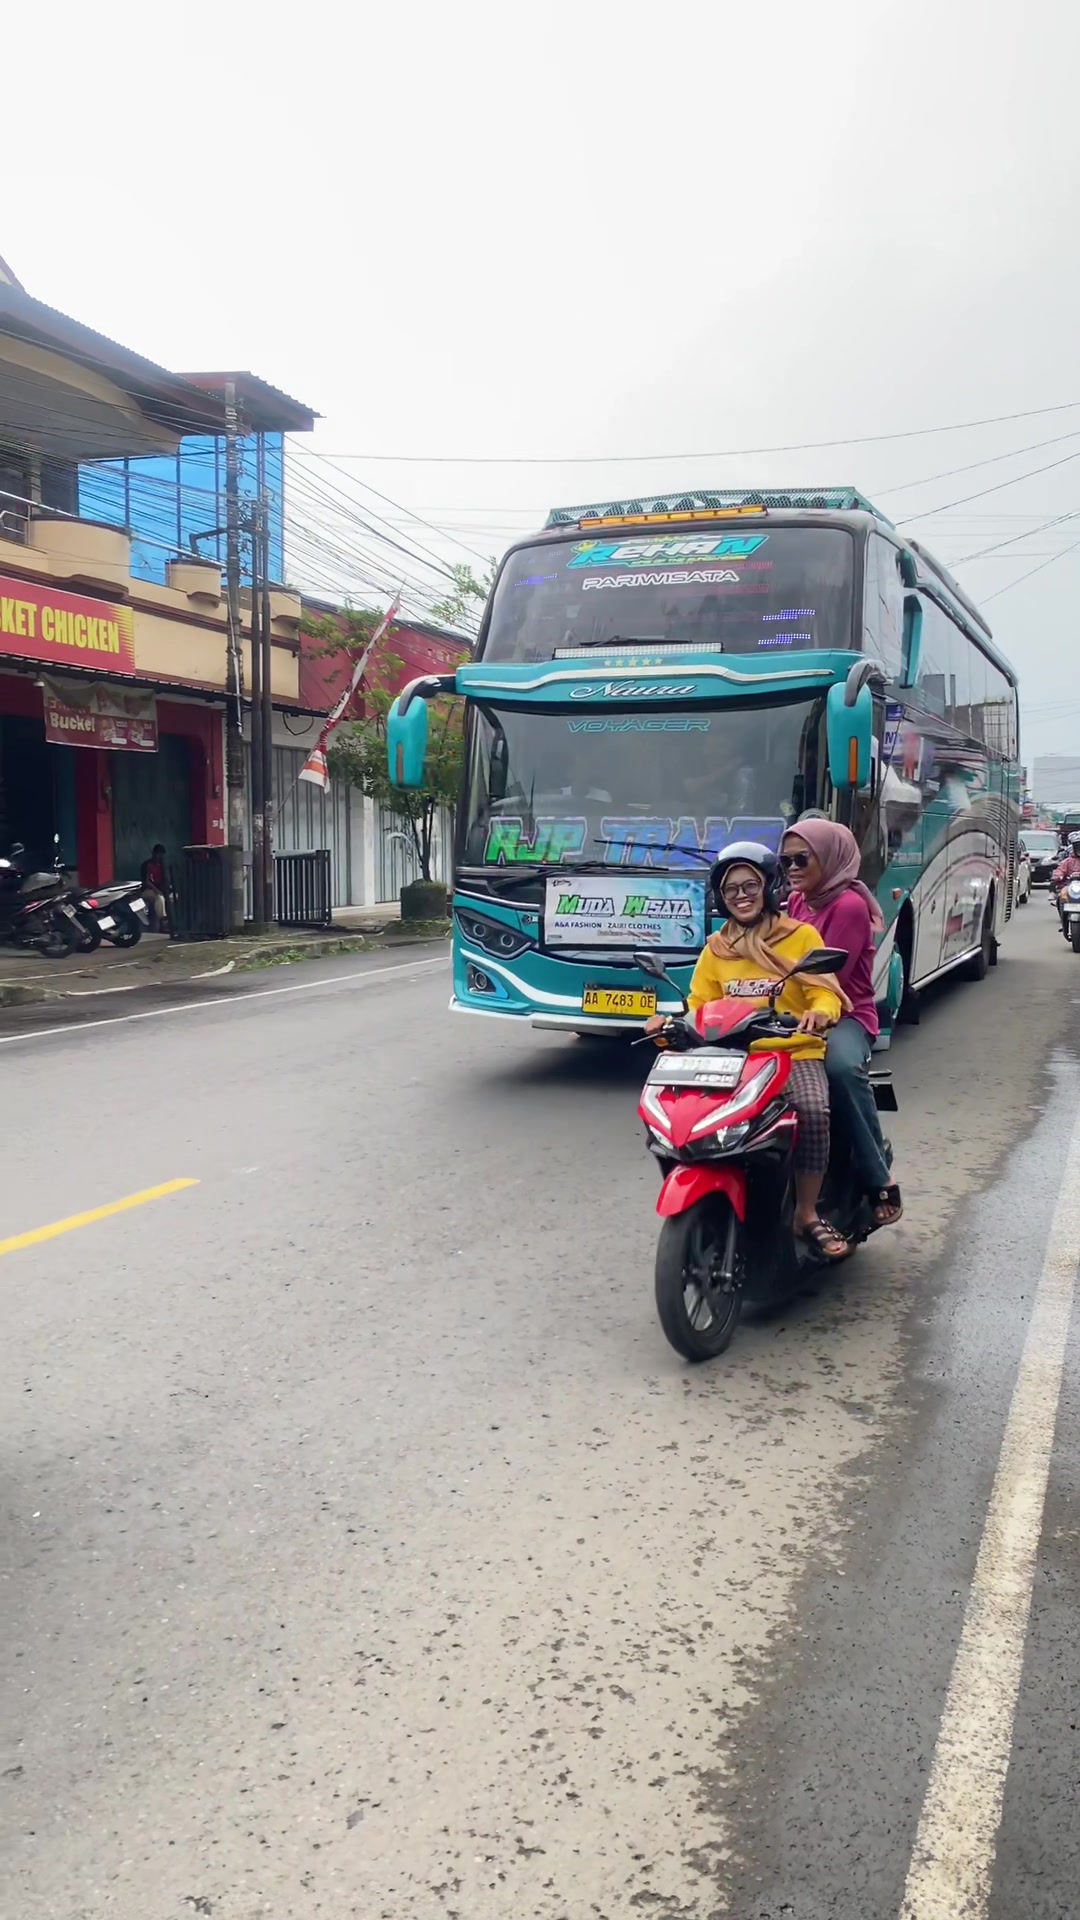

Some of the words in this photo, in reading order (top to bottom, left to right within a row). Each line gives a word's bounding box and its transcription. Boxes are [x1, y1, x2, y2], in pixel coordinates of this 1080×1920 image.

[582, 570, 740, 590] PARIWISATA
[0, 597, 37, 638] KET
[41, 606, 120, 653] CHICKEN
[567, 718, 711, 733] VOYAGER
[484, 816, 587, 866] RJP
[555, 894, 615, 917] MUDA
[621, 895, 692, 919] WISATA
[584, 992, 599, 1005] AA
[605, 993, 634, 1007] 7483
